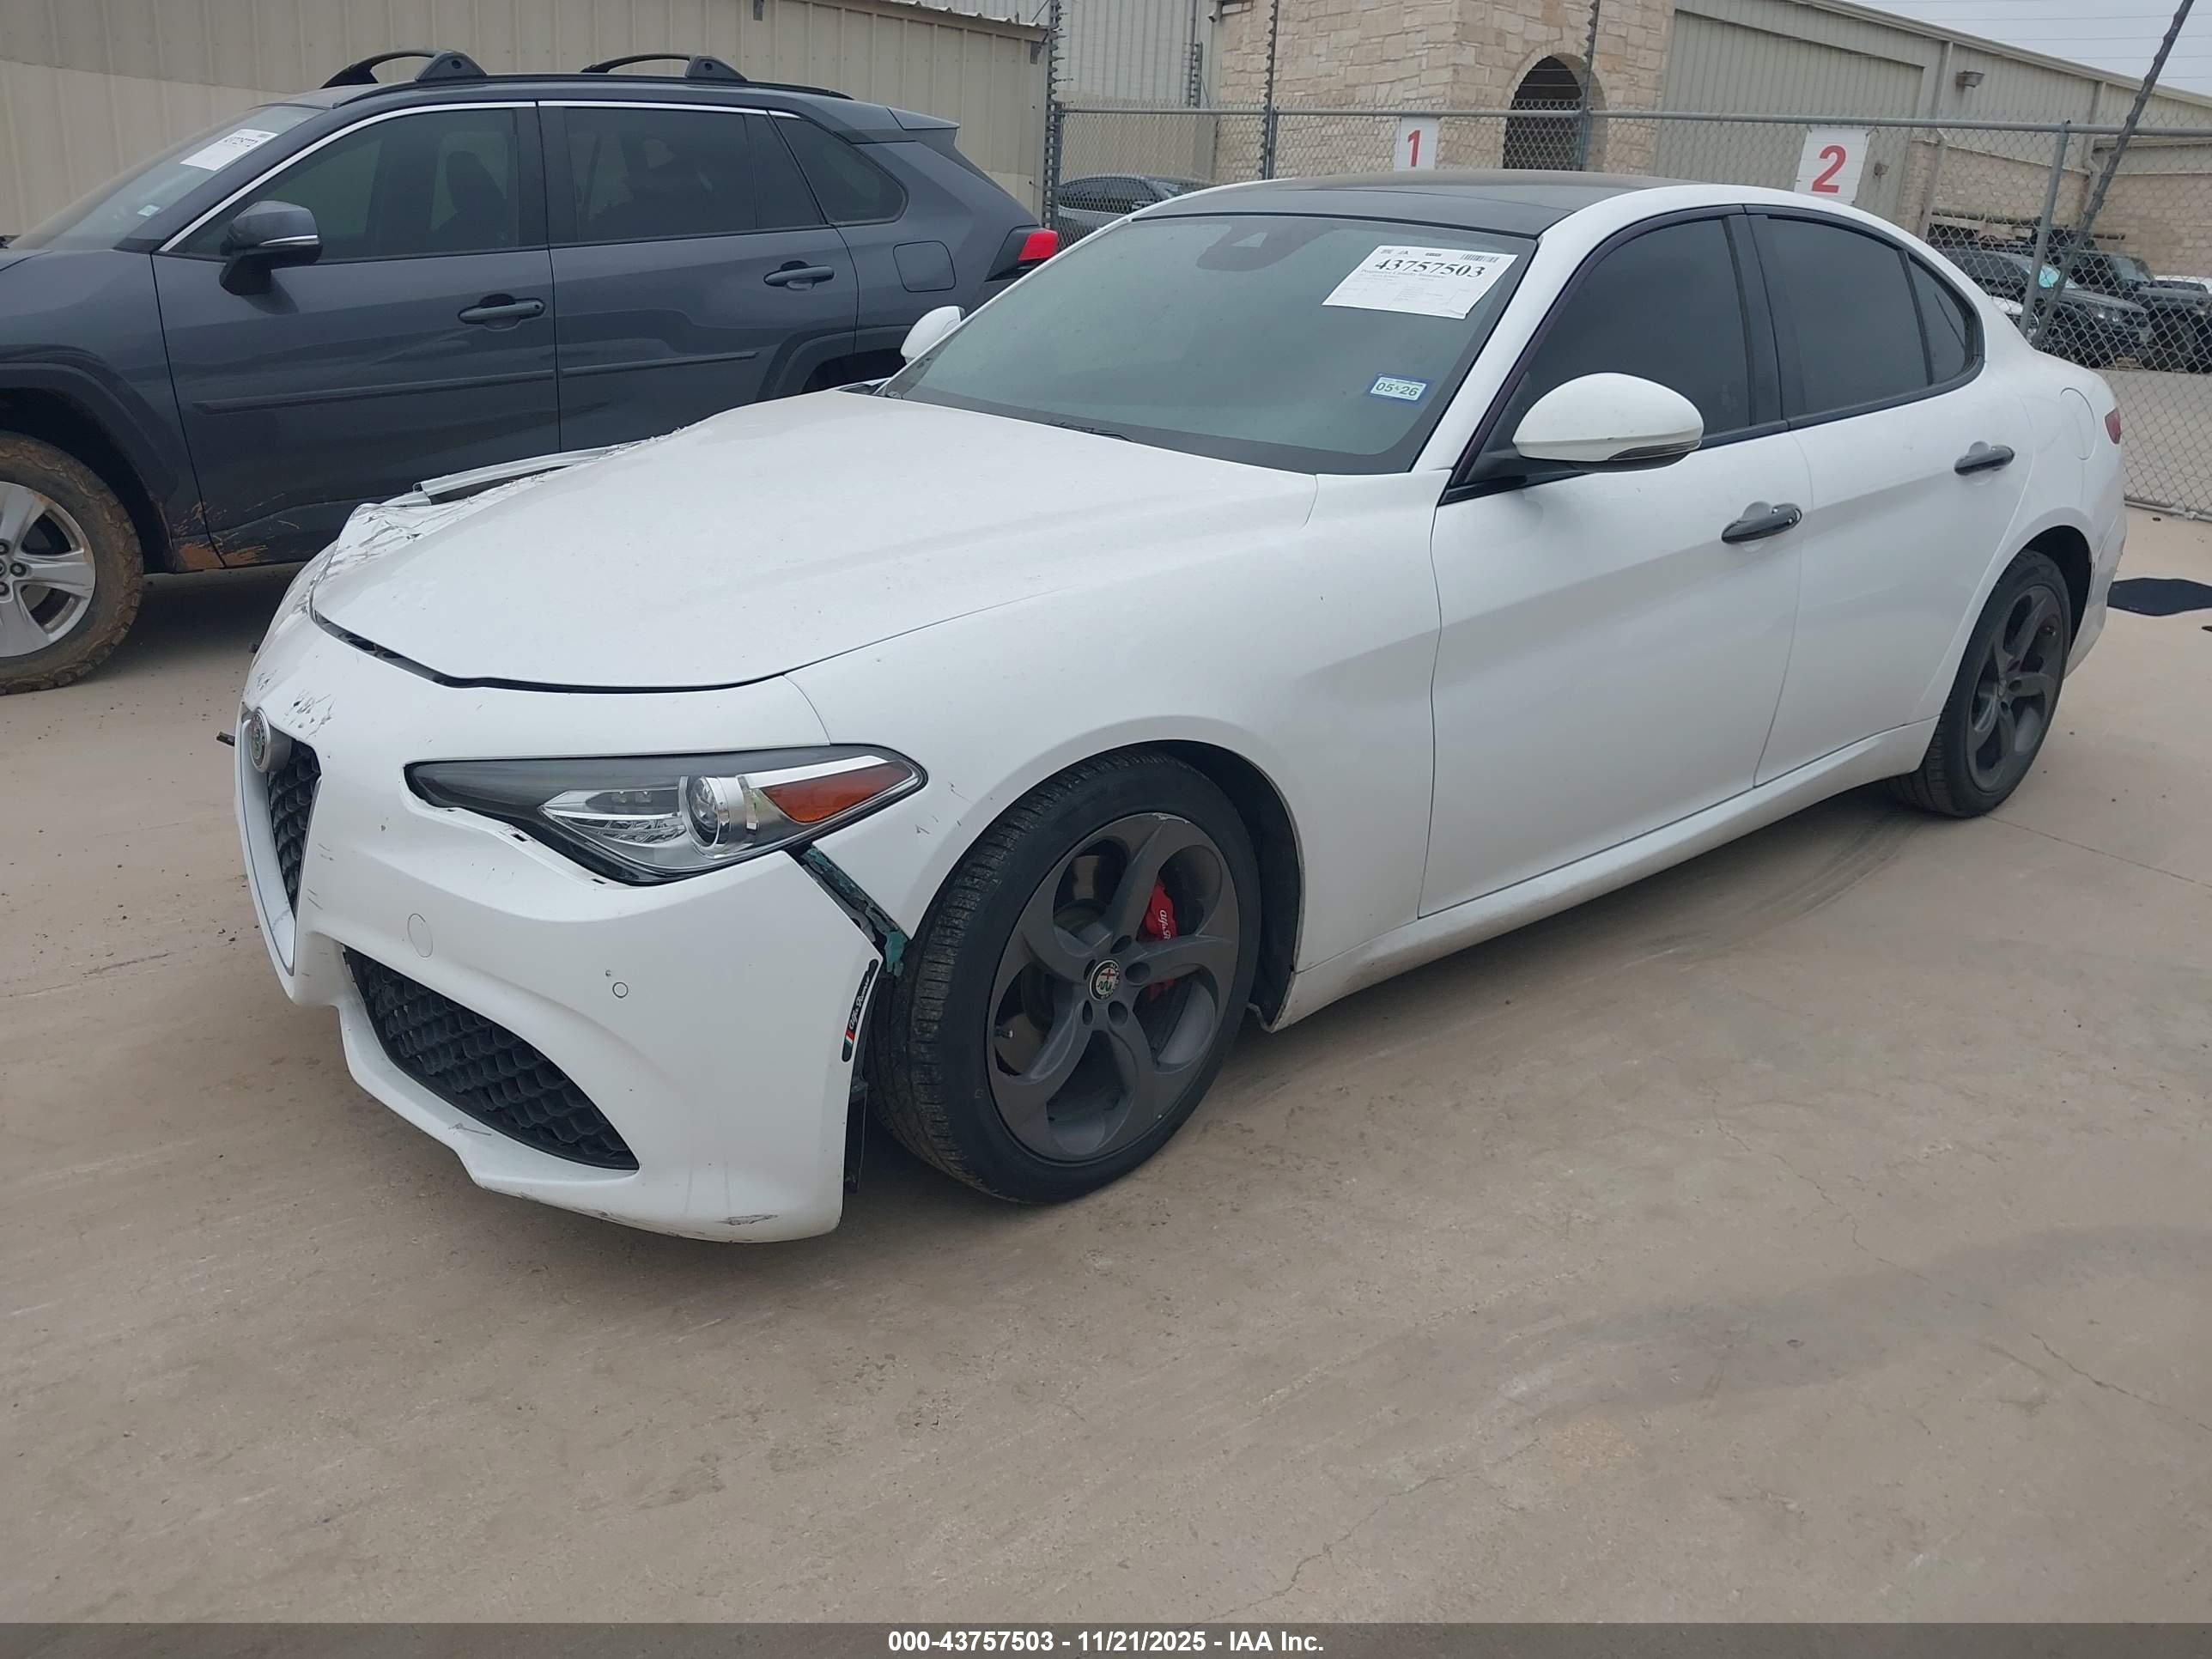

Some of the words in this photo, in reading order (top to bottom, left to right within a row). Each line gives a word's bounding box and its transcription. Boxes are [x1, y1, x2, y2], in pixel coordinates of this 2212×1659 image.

[1407, 130, 1420, 167] 1
[1812, 145, 1846, 193] 2
[1375, 258, 1486, 278] 43757503
[1376, 382, 1395, 392] 05
[1399, 386, 1419, 397] 26
